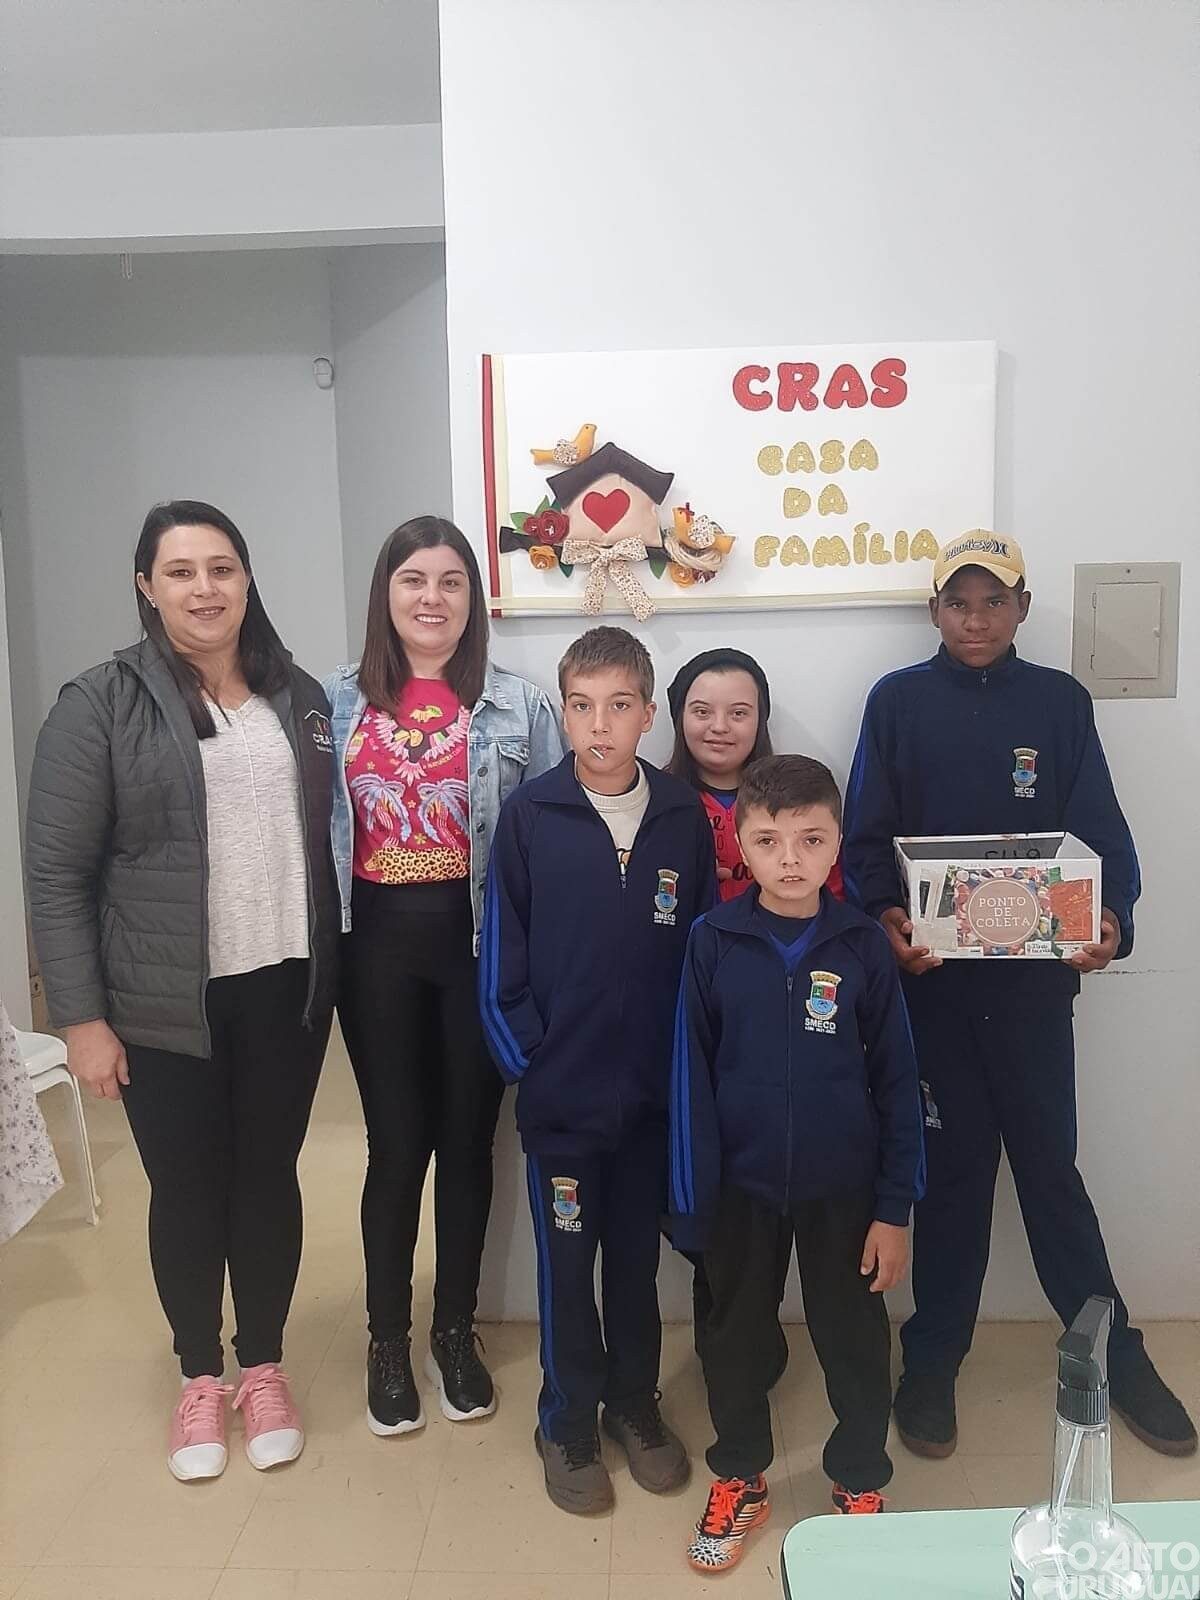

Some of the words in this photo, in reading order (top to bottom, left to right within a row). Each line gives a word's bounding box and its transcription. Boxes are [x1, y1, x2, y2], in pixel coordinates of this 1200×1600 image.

[733, 358, 908, 412] CRAS
[757, 439, 879, 476] CASA
[782, 484, 848, 519] DA
[754, 522, 939, 568] FAMÍLIA
[979, 896, 1026, 907] PONTO
[994, 907, 1012, 917] DE
[976, 917, 1031, 928] COLETA
[804, 1017, 836, 1030] SMECD
